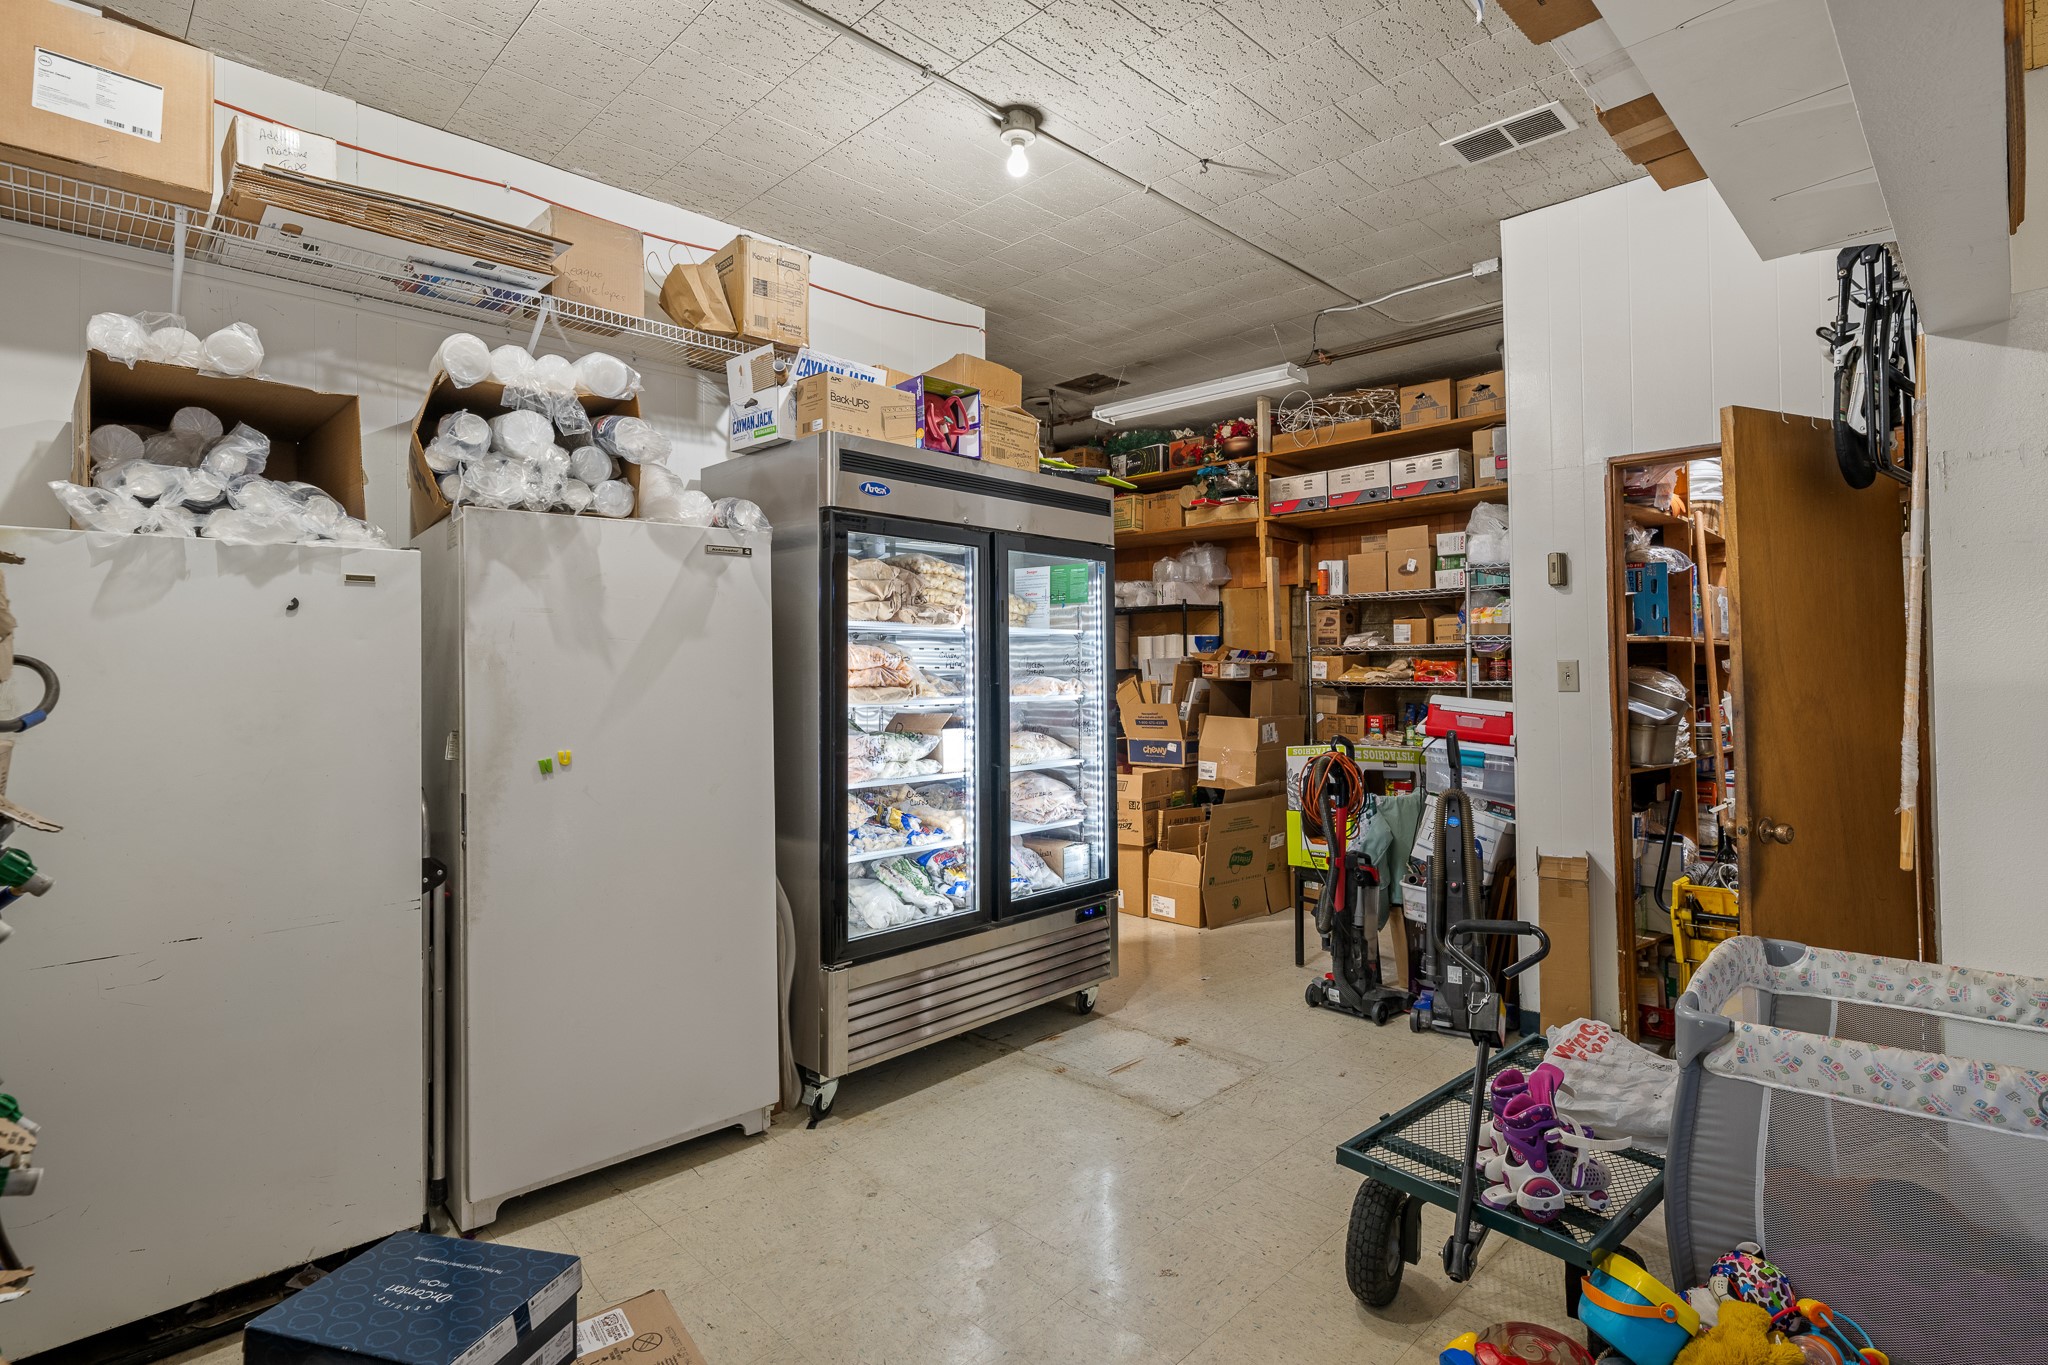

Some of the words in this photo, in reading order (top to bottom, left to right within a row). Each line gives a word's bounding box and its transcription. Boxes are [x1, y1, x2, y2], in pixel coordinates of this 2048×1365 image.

[563, 255, 604, 282] League
[830, 391, 869, 410] Back-UPS
[732, 414, 755, 435] CAYMAN
[755, 410, 773, 428] JACK
[1143, 745, 1167, 756] chewy
[1363, 750, 1415, 761] PISTACHIOS
